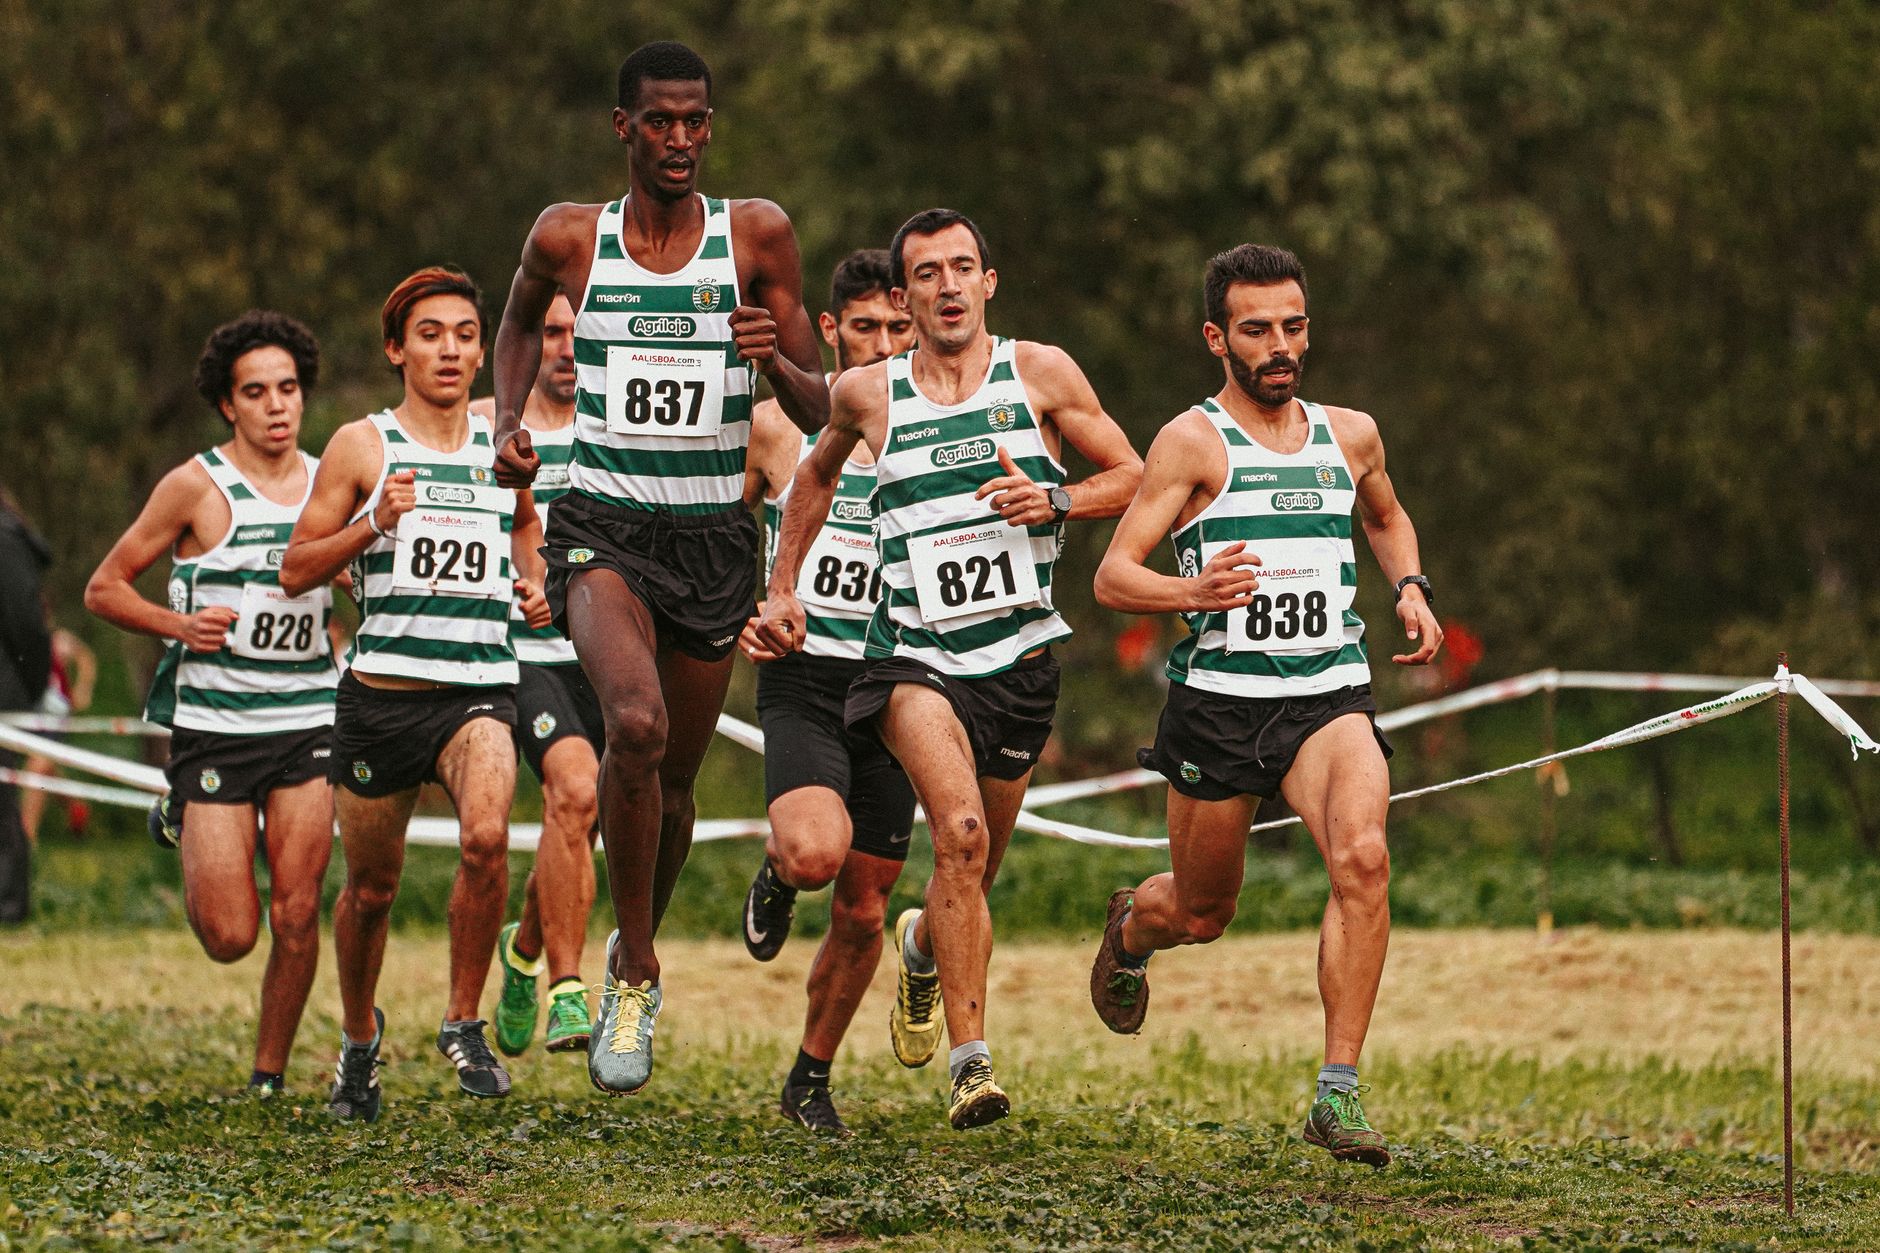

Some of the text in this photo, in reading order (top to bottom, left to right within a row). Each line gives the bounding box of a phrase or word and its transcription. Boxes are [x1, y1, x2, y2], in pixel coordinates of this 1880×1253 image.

[596, 293, 641, 303] macron
[635, 319, 690, 336] Agriloja
[631, 354, 695, 364] AALISBOA.com
[625, 378, 705, 426] 837
[897, 427, 940, 442] macron
[937, 443, 991, 463] Agriloja
[431, 487, 471, 503] Agriloja
[1277, 494, 1318, 508] Agriloja
[838, 502, 872, 517] Agrilo
[421, 515, 478, 526] AALISBOA.com
[933, 530, 996, 547] AALISBOA.com
[411, 537, 487, 583] 829
[937, 551, 1017, 607] 821
[1255, 568, 1314, 578] AALISBOA.com
[1245, 590, 1328, 641] 838
[250, 612, 313, 651] 828
[1000, 747, 1031, 760] macron
